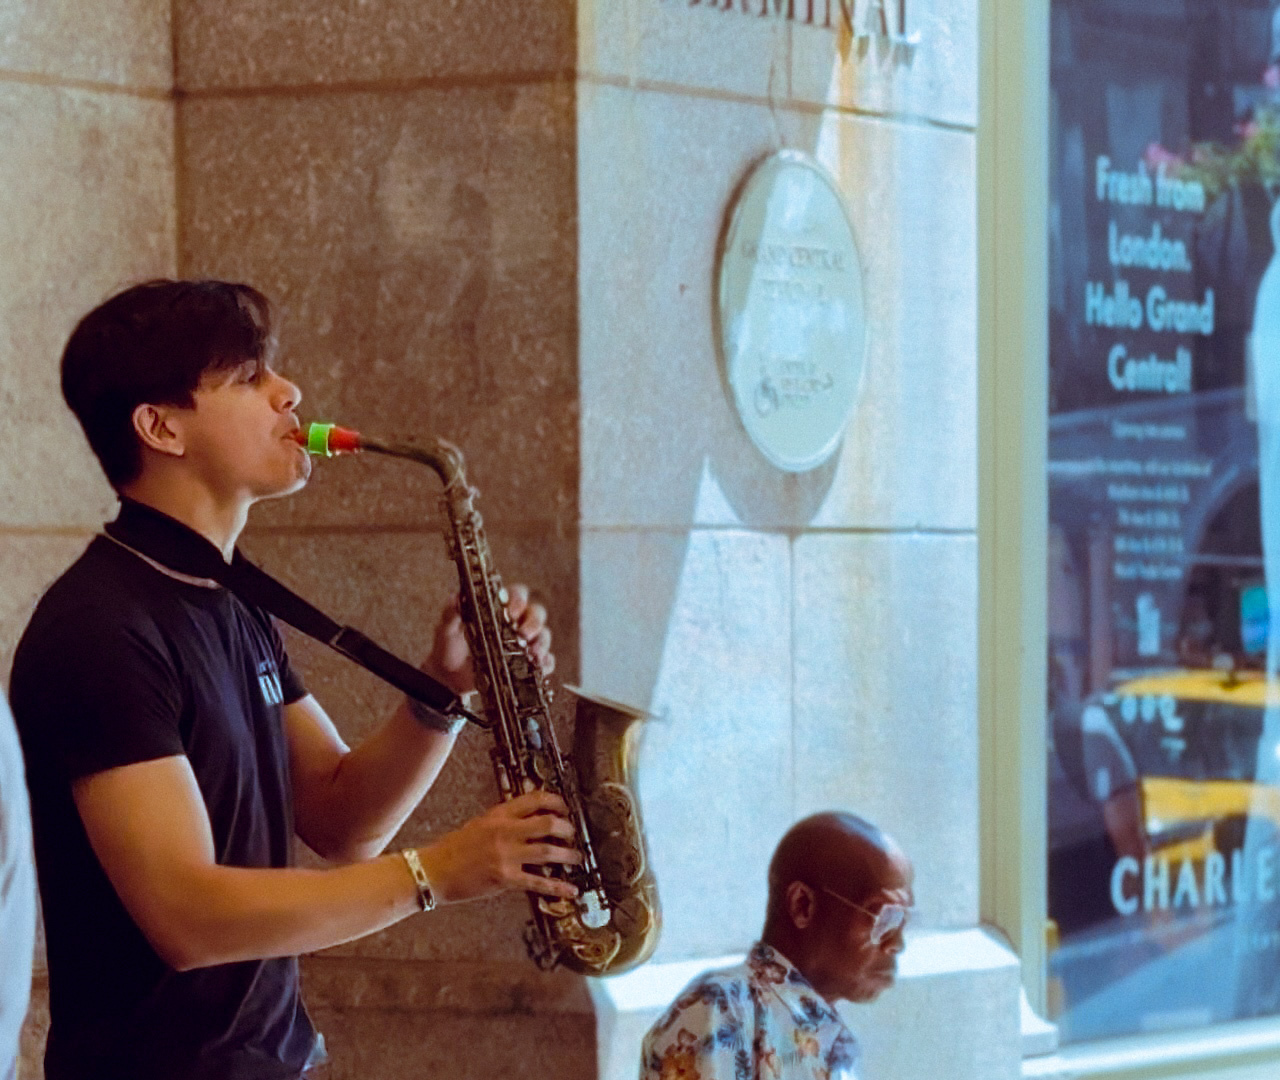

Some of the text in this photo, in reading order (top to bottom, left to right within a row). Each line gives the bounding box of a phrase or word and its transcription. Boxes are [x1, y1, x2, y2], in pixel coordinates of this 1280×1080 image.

[1097, 155, 1204, 211] Fresh from
[1085, 280, 1215, 335] Hello Grand
